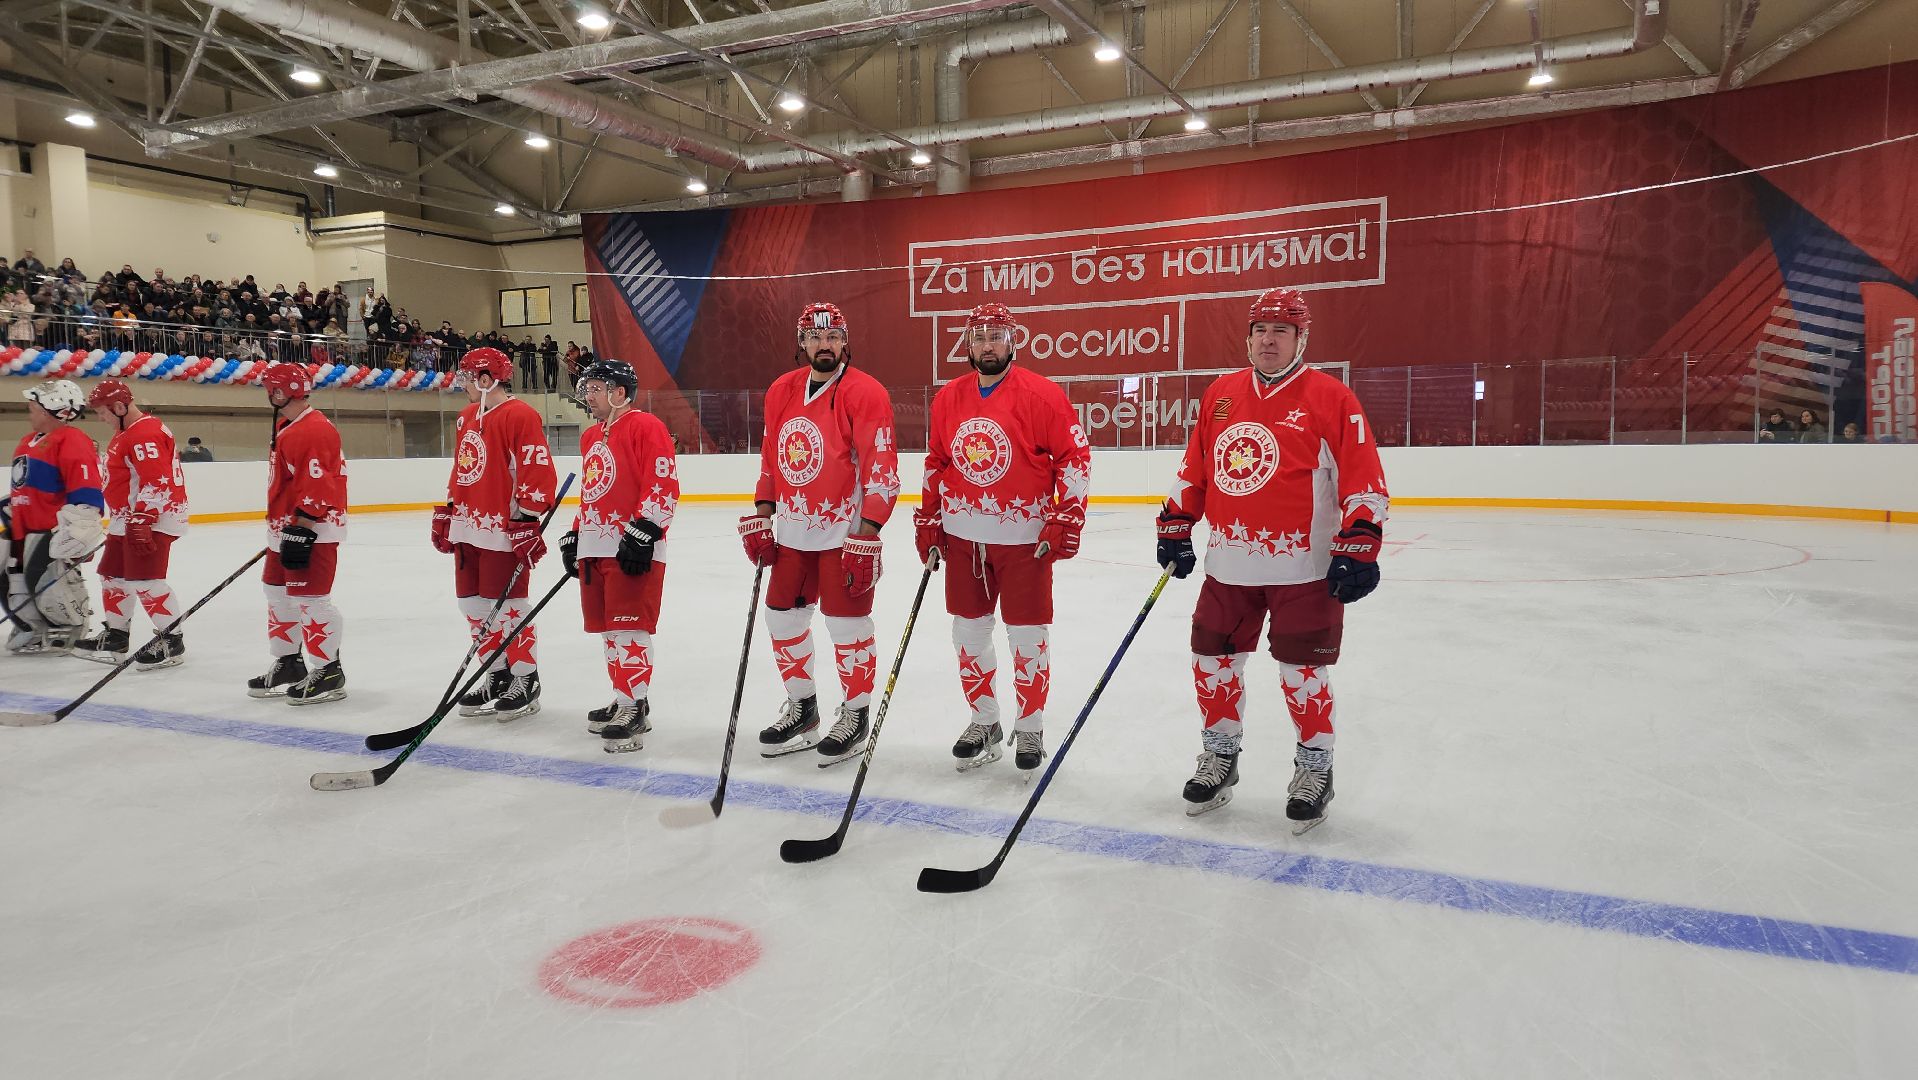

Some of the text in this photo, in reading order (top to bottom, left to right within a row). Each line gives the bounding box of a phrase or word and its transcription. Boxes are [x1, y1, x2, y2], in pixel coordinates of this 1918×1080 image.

[921, 218, 1367, 296] Zа мир без нацизма!
[1012, 314, 1170, 362] Россию!
[1069, 424, 1089, 448] 2
[1219, 426, 1274, 455] ЛЕГЕНДЫ
[1349, 414, 1367, 445] 7
[133, 442, 159, 462] 65
[521, 445, 549, 466] 72
[80, 464, 89, 480] 1
[308, 458, 323, 479] 6
